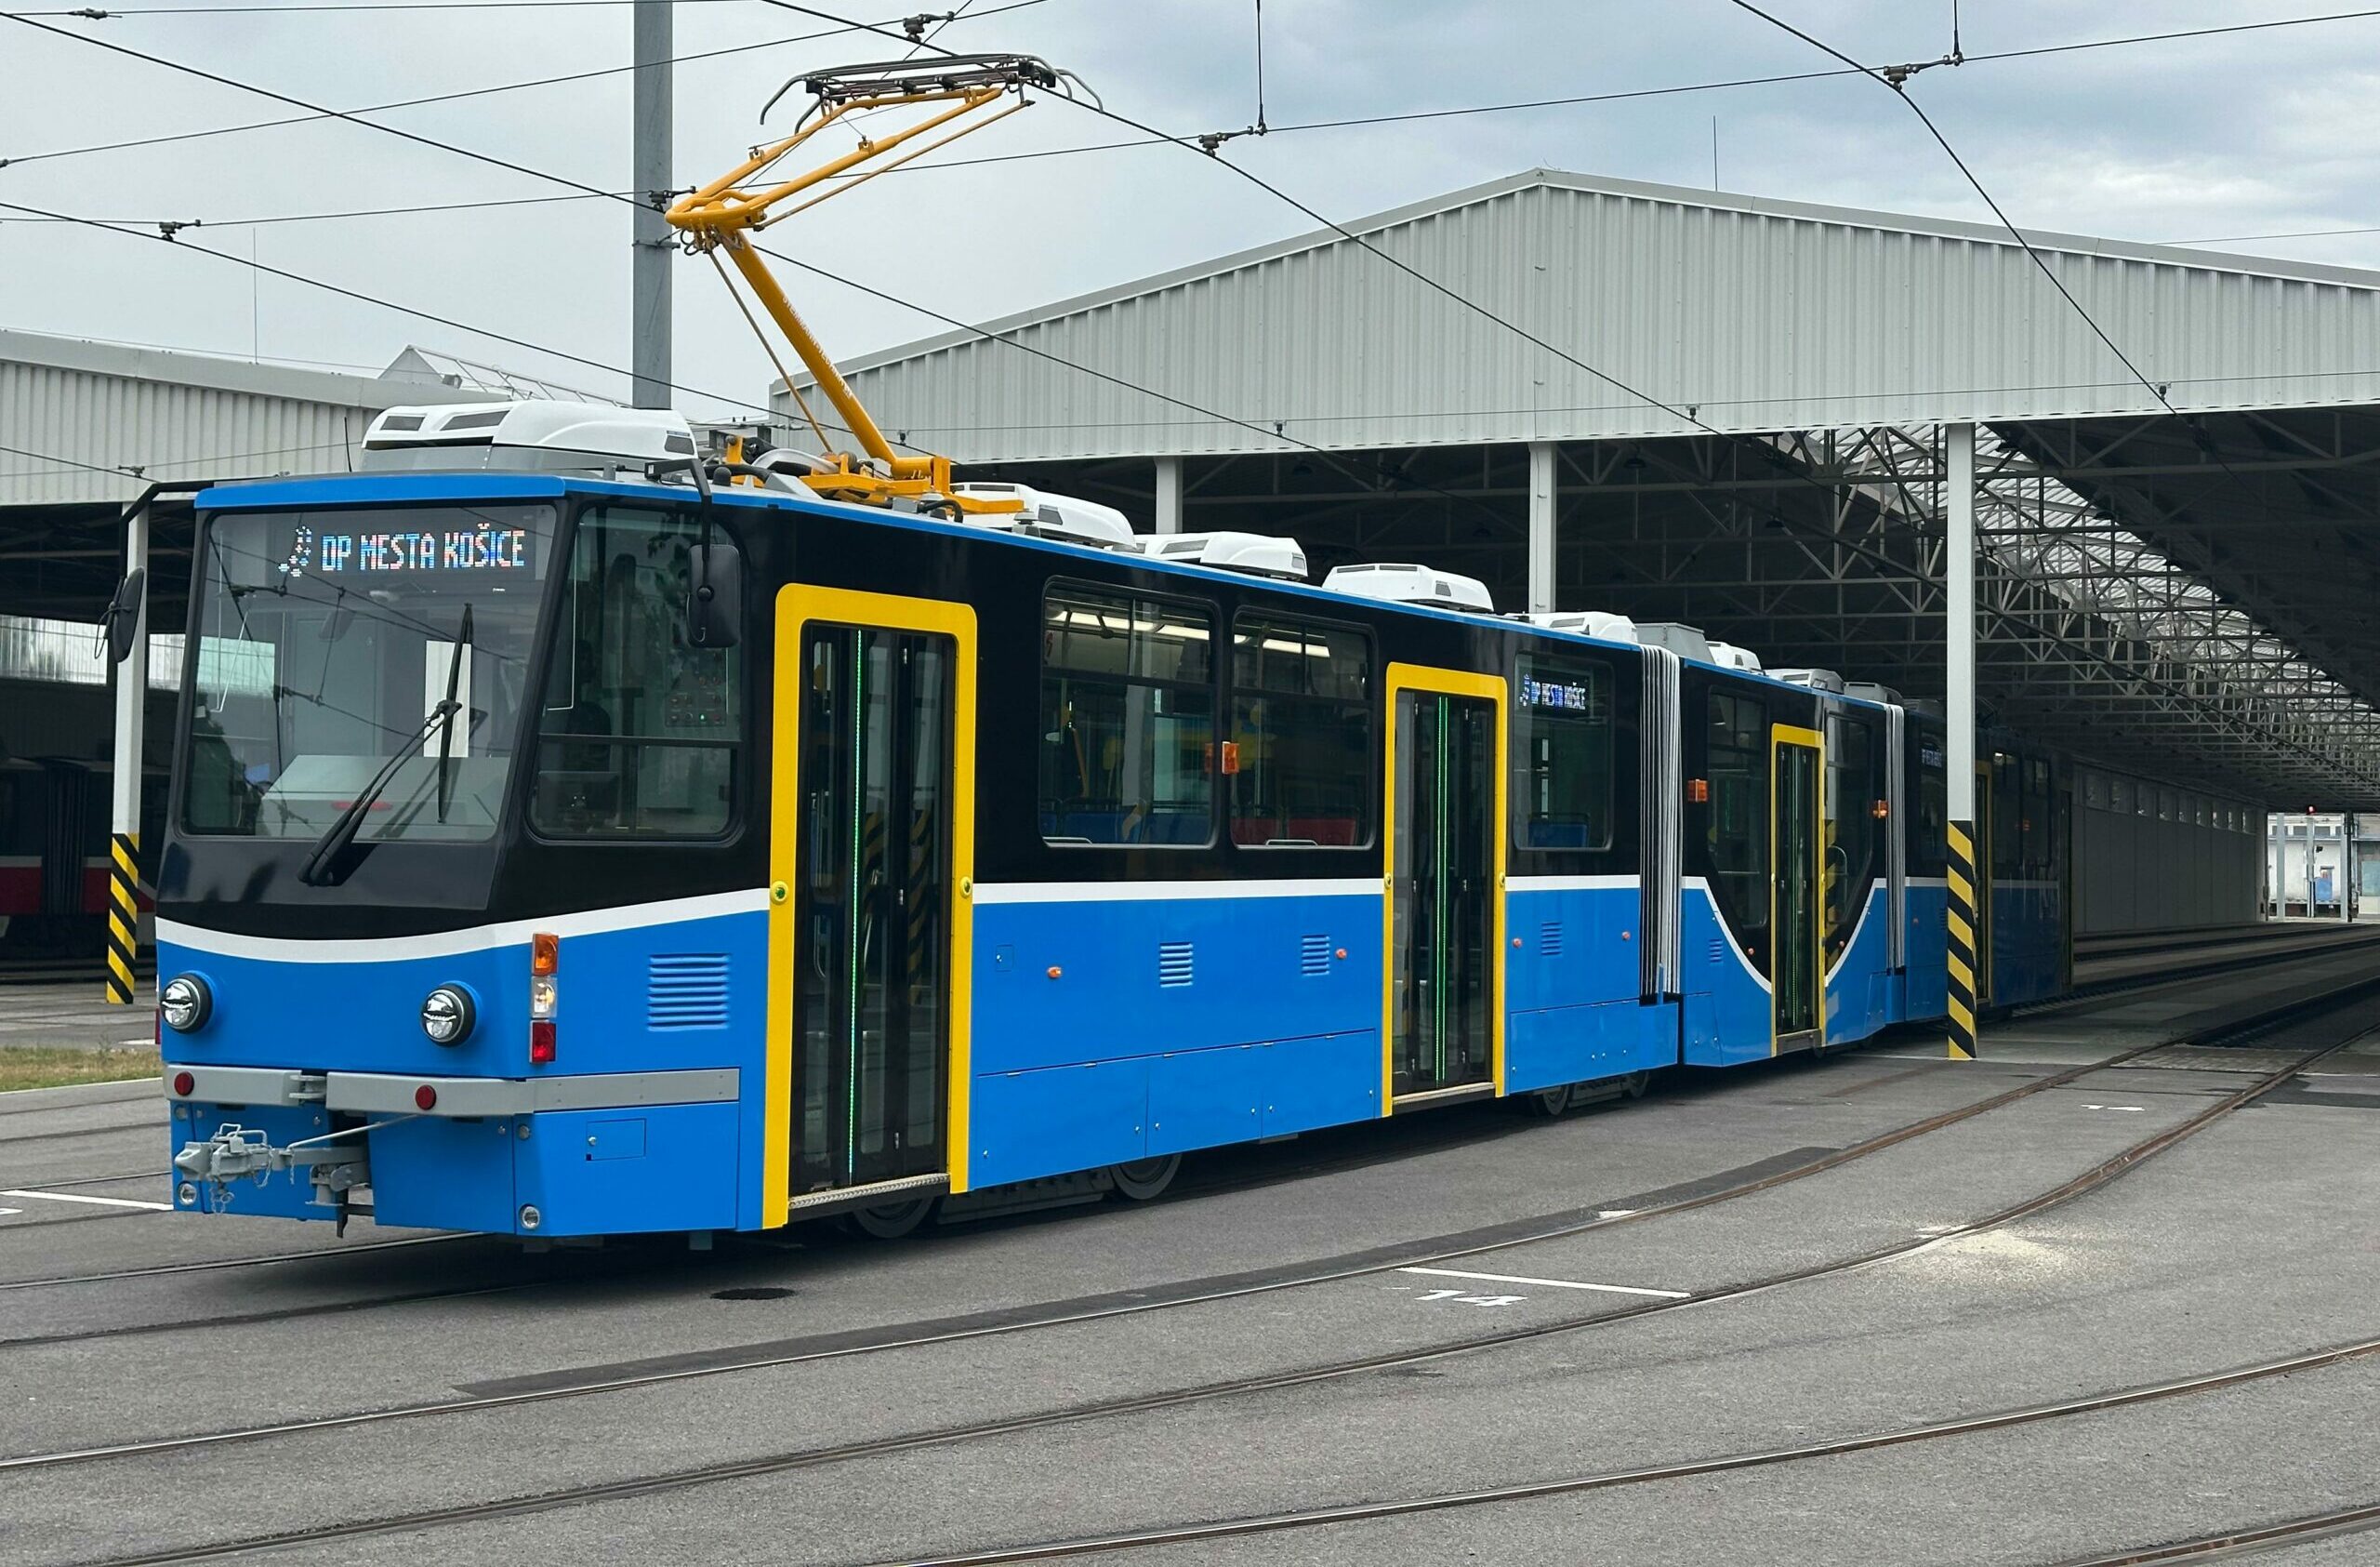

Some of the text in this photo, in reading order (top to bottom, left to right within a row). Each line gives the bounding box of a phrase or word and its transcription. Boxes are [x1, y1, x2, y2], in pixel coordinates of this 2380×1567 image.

[321, 523, 525, 571] DP MESTA KOŠICE
